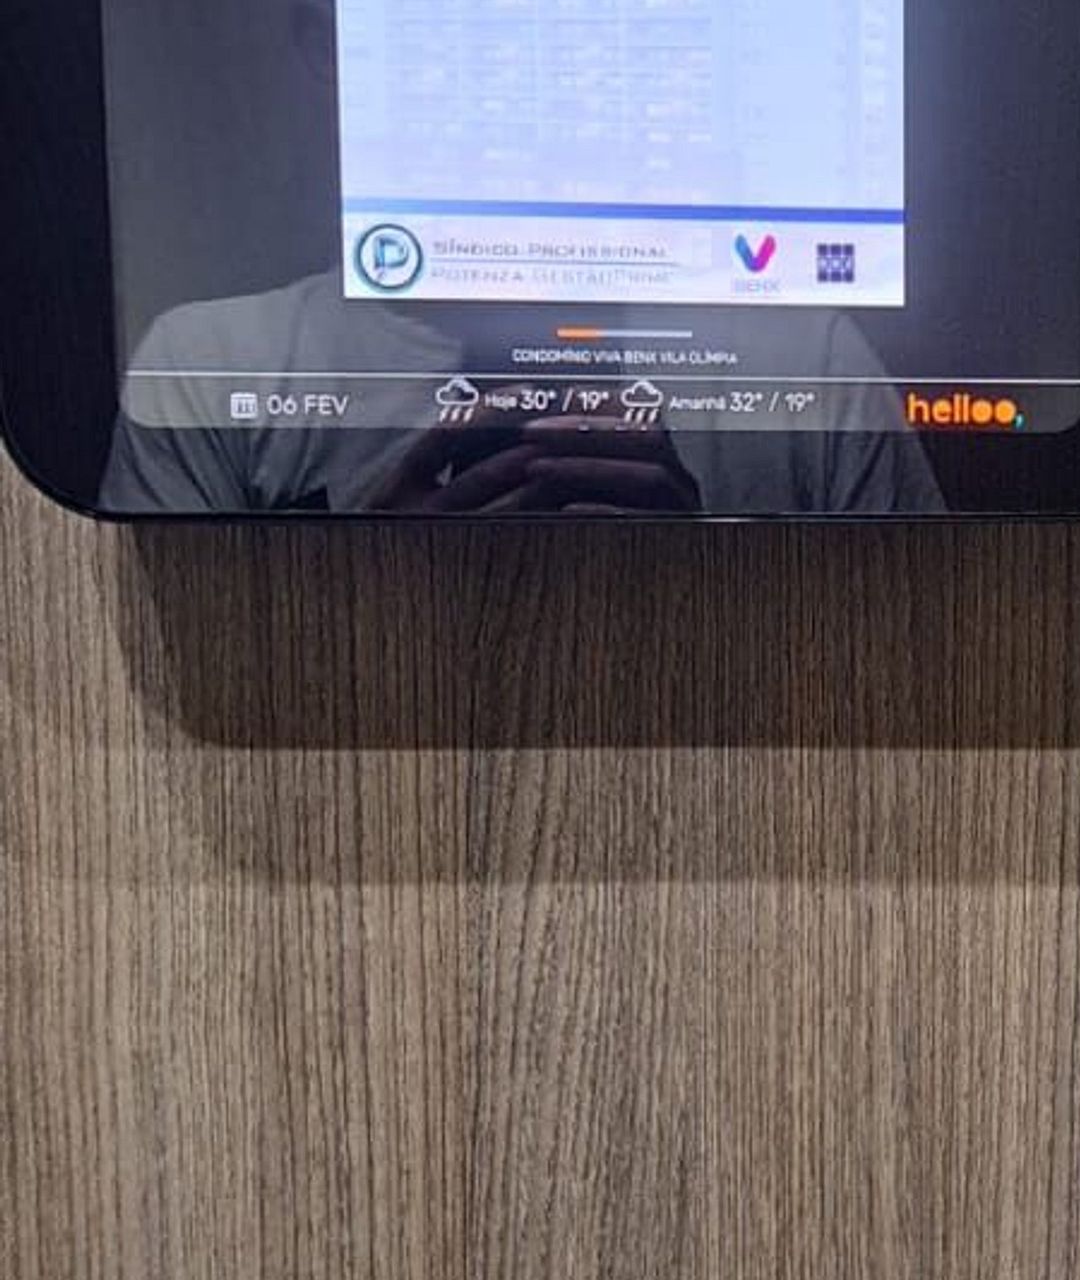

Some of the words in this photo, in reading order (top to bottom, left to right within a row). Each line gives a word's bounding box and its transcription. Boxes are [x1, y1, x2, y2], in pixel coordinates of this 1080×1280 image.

[432, 239, 519, 257] SÍNDICO
[266, 393, 297, 416] 06
[305, 394, 349, 417] FEV
[485, 394, 518, 412] Hoje
[521, 389, 558, 411] 30°
[581, 389, 611, 411] 19°
[669, 395, 727, 412] Amanhã
[730, 391, 764, 412] 32°
[785, 391, 816, 413] 19°
